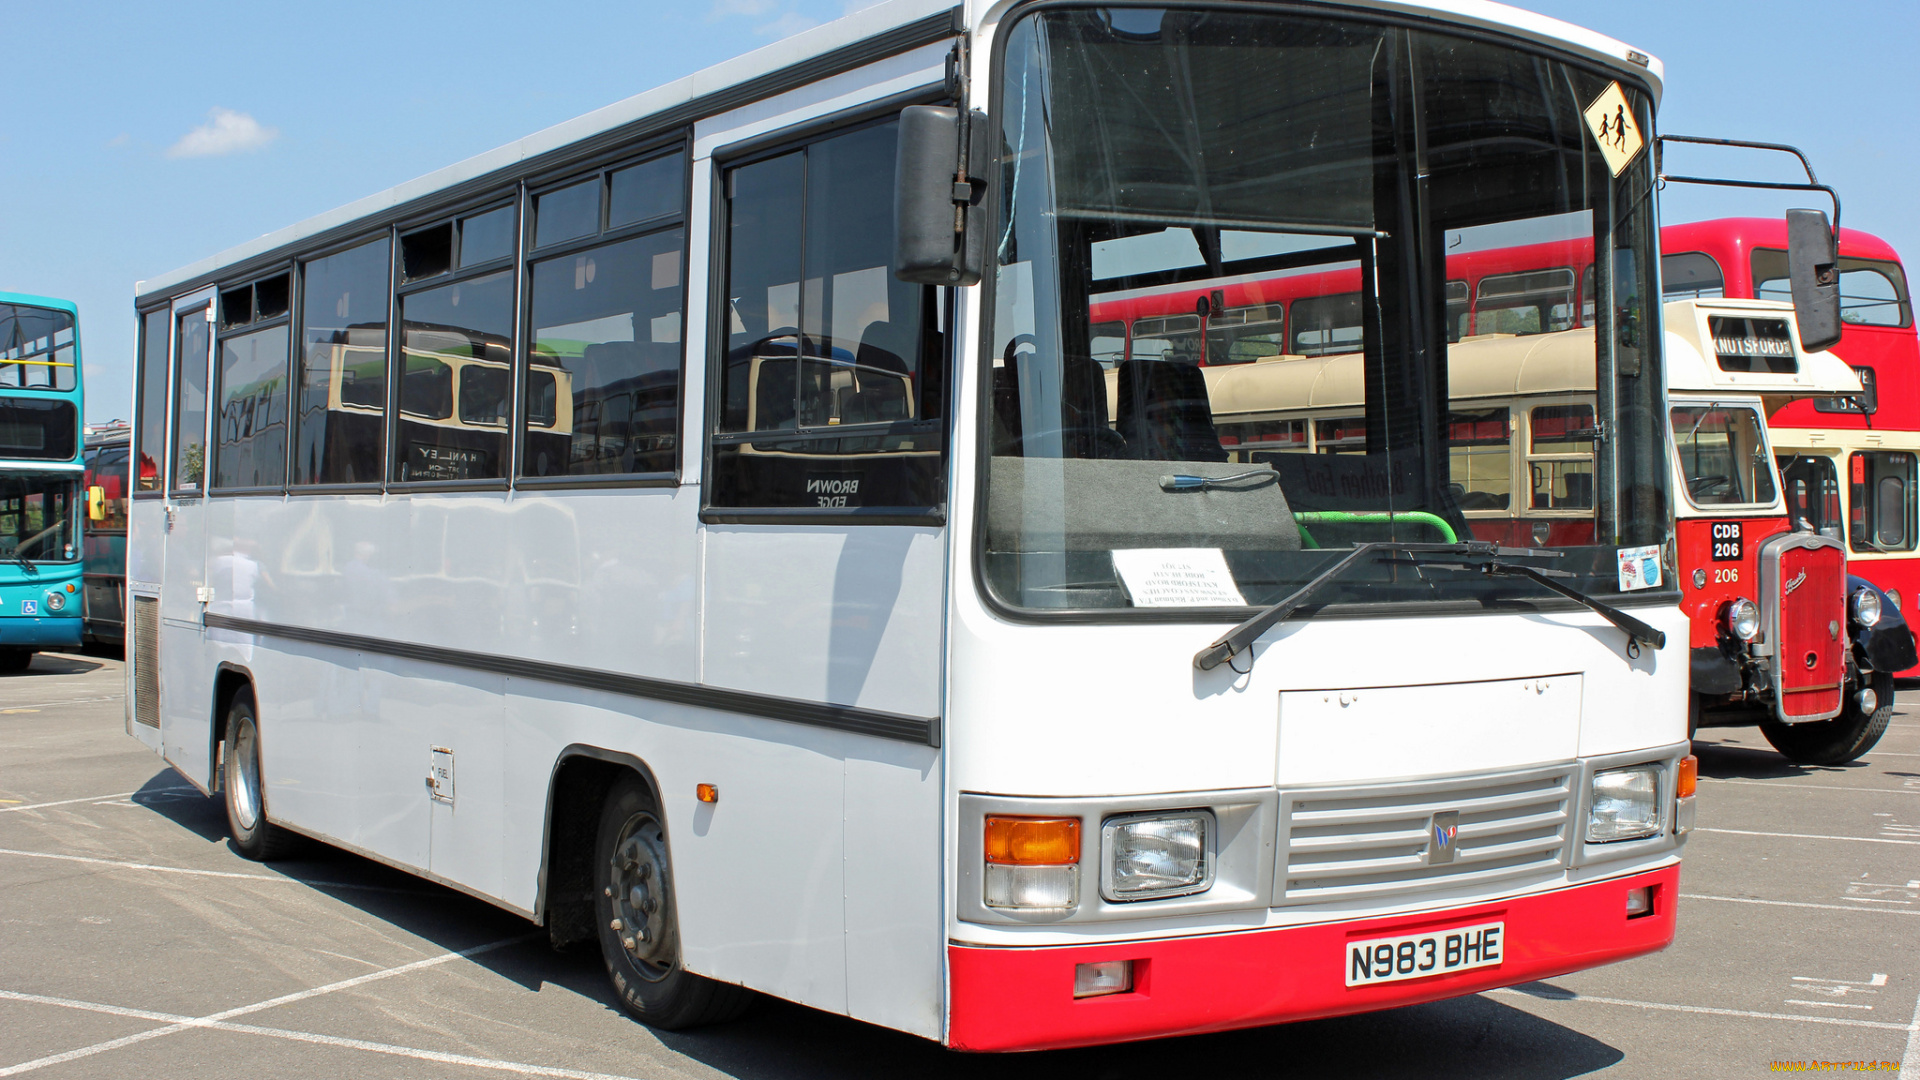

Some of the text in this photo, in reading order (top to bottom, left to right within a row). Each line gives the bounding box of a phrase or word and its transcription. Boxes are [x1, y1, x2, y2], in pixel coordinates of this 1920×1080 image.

[1713, 337, 1785, 354] KNUTSFORD
[1713, 524, 1740, 538] CDB
[1714, 543, 1739, 557] 206
[1714, 568, 1739, 583] 206
[1171, 580, 1218, 588] KNUTSFORD
[1352, 927, 1500, 981] N983 BHE
